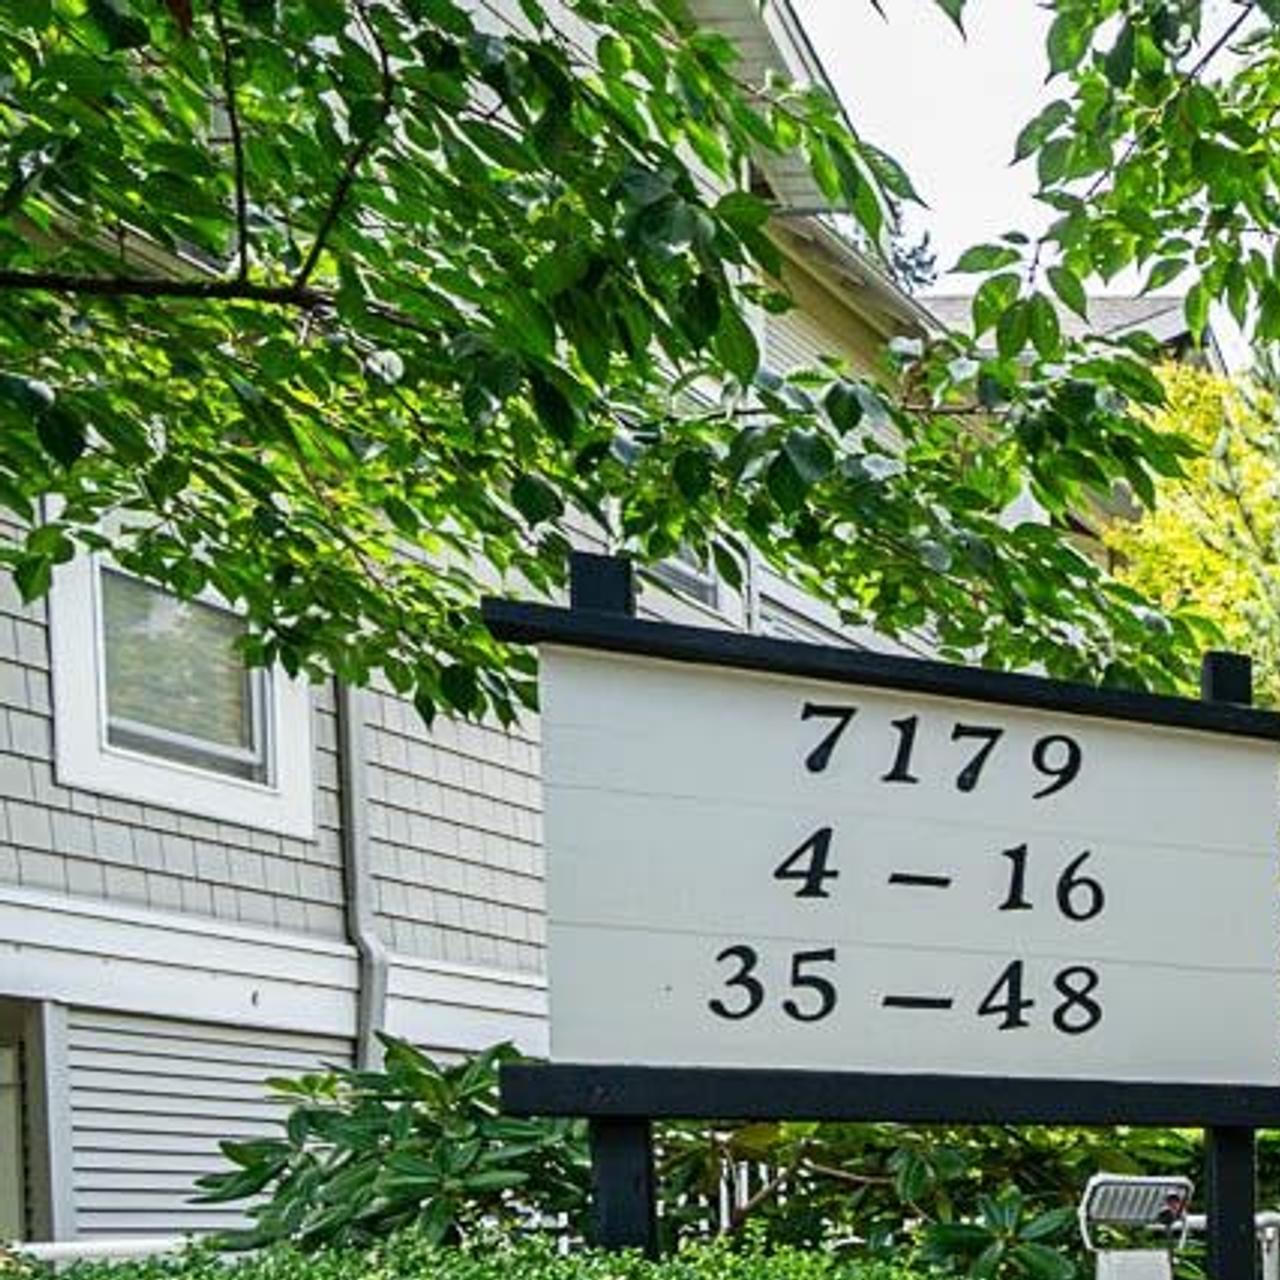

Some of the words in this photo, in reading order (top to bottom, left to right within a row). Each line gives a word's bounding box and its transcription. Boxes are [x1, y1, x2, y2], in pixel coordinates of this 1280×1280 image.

[799, 700, 1084, 801] 7179
[772, 826, 841, 900] 4
[997, 842, 1106, 923] 16
[707, 943, 838, 1024] 35
[976, 958, 1103, 1036] 48
